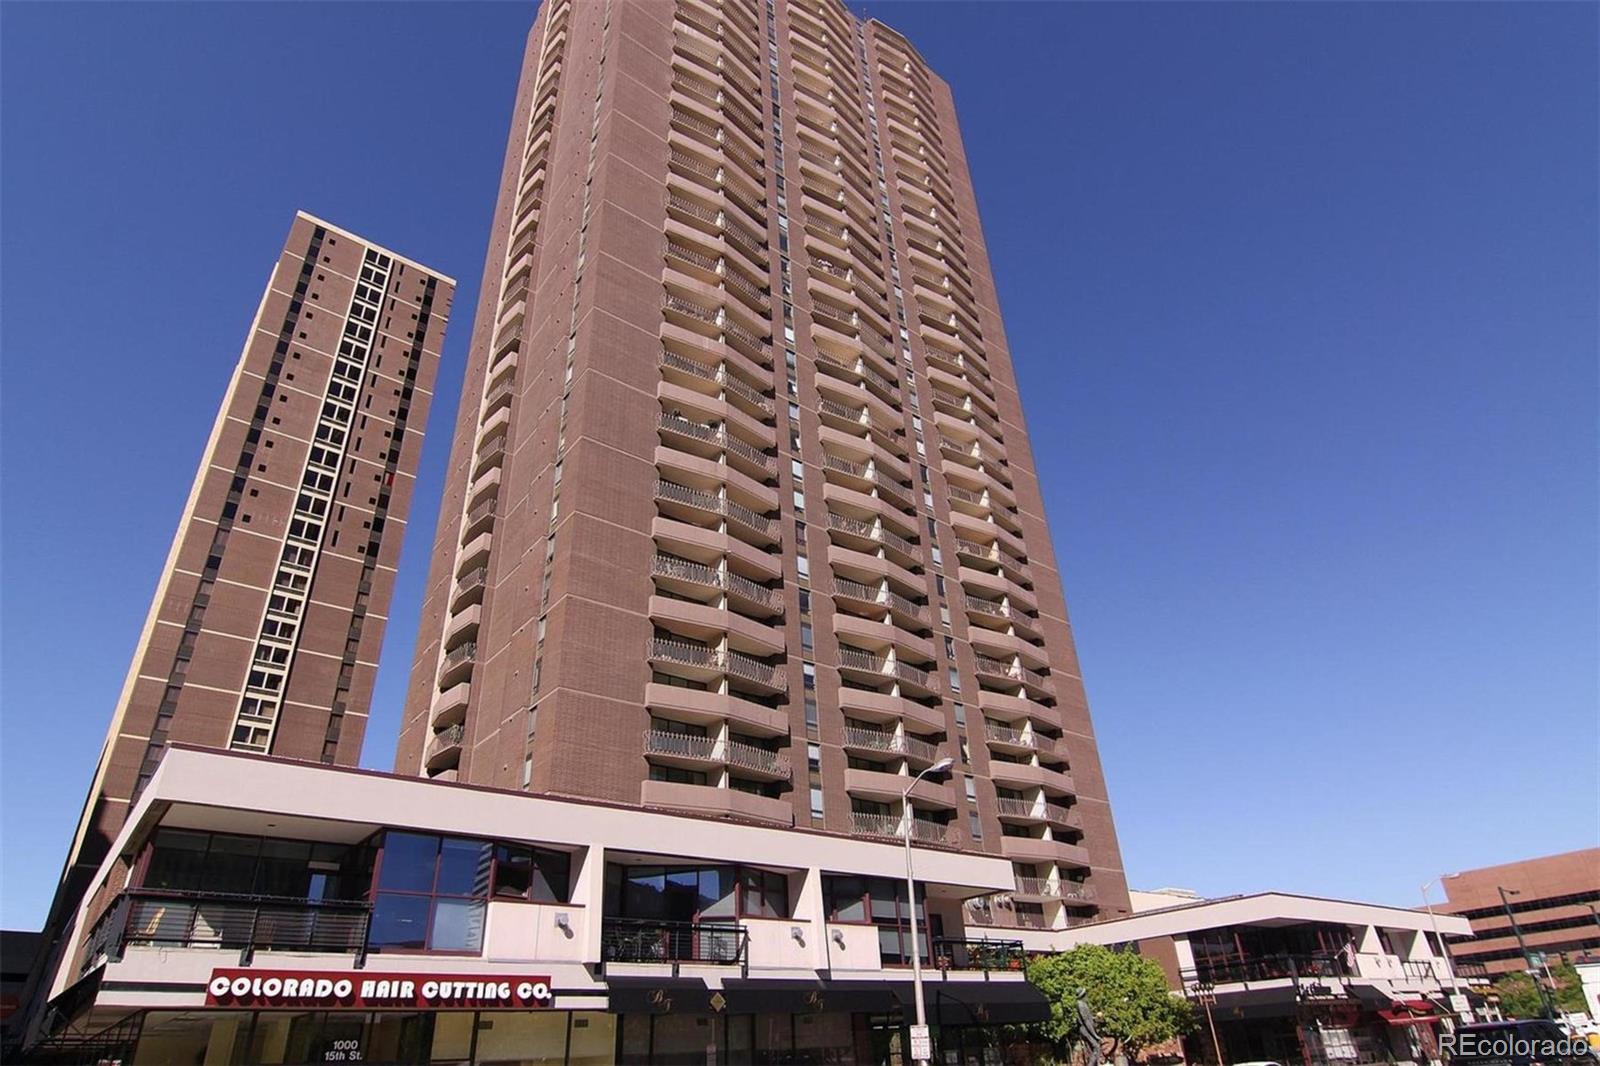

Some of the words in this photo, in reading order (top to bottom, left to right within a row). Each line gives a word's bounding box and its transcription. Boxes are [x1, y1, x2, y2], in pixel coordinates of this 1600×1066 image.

[209, 976, 353, 998] COLORADO
[360, 980, 415, 998] HAIR
[421, 981, 511, 998] CUTTING
[516, 982, 552, 999] CO.
[333, 1040, 358, 1050] 1000
[325, 1051, 345, 1061] 15th
[349, 1051, 363, 1061] St.
